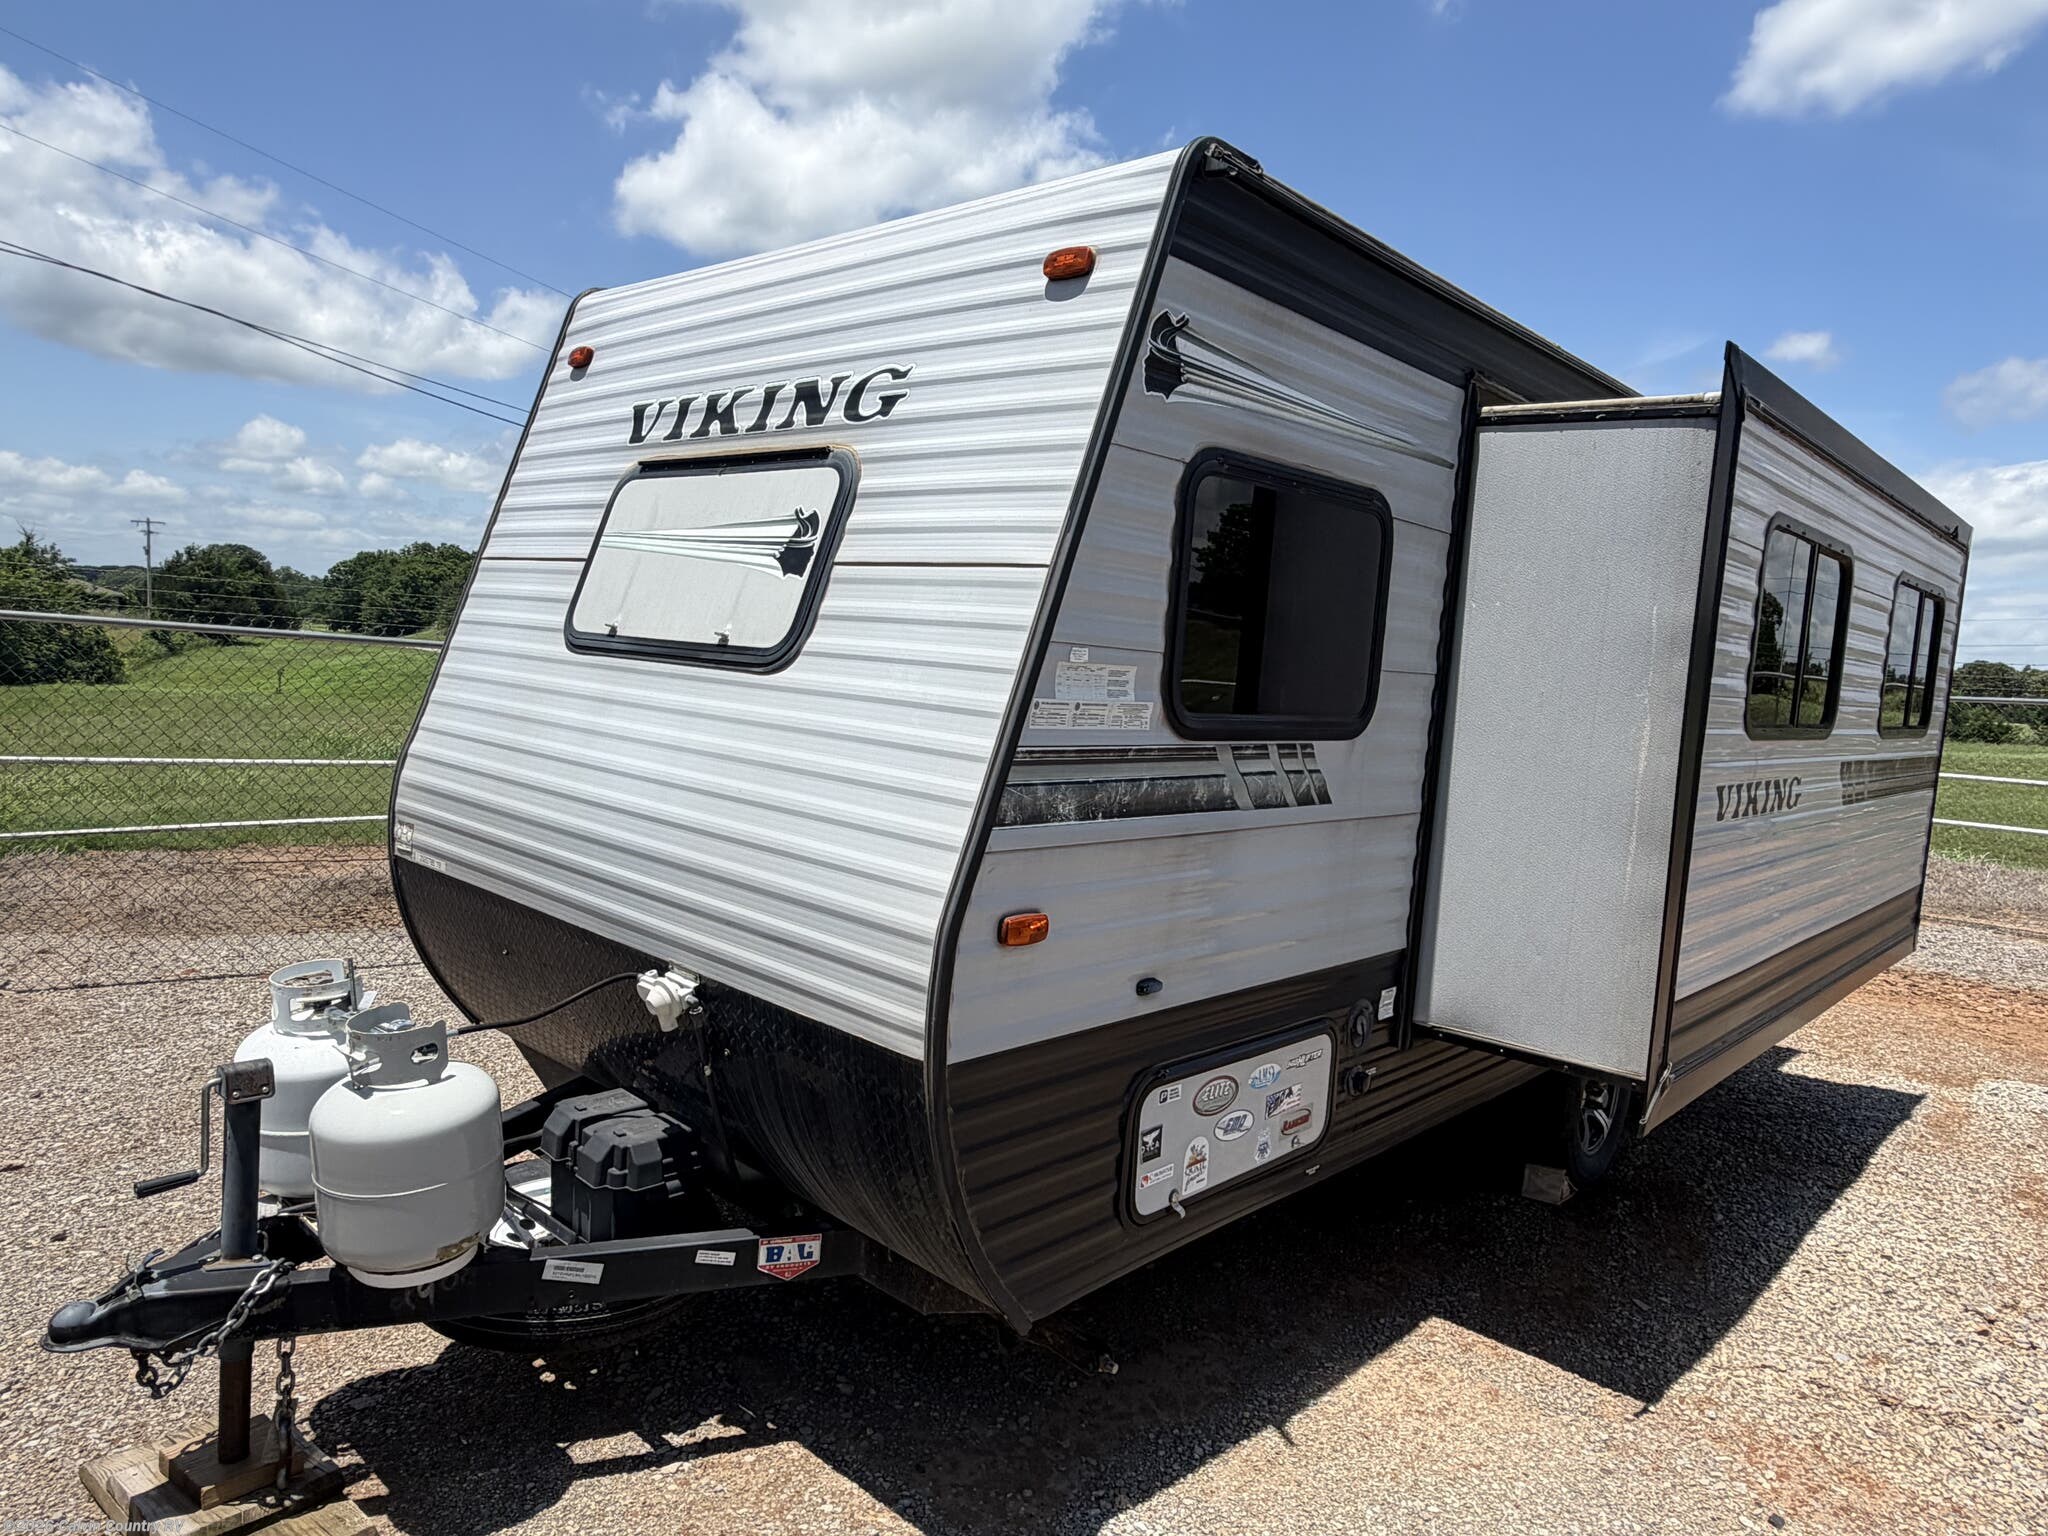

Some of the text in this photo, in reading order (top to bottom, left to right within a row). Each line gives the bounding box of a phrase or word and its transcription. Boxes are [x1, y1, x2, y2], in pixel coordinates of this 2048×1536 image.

[628, 364, 916, 445] VIKING
[1716, 777, 1801, 821] VIKING
[766, 1244, 813, 1263] BAL
